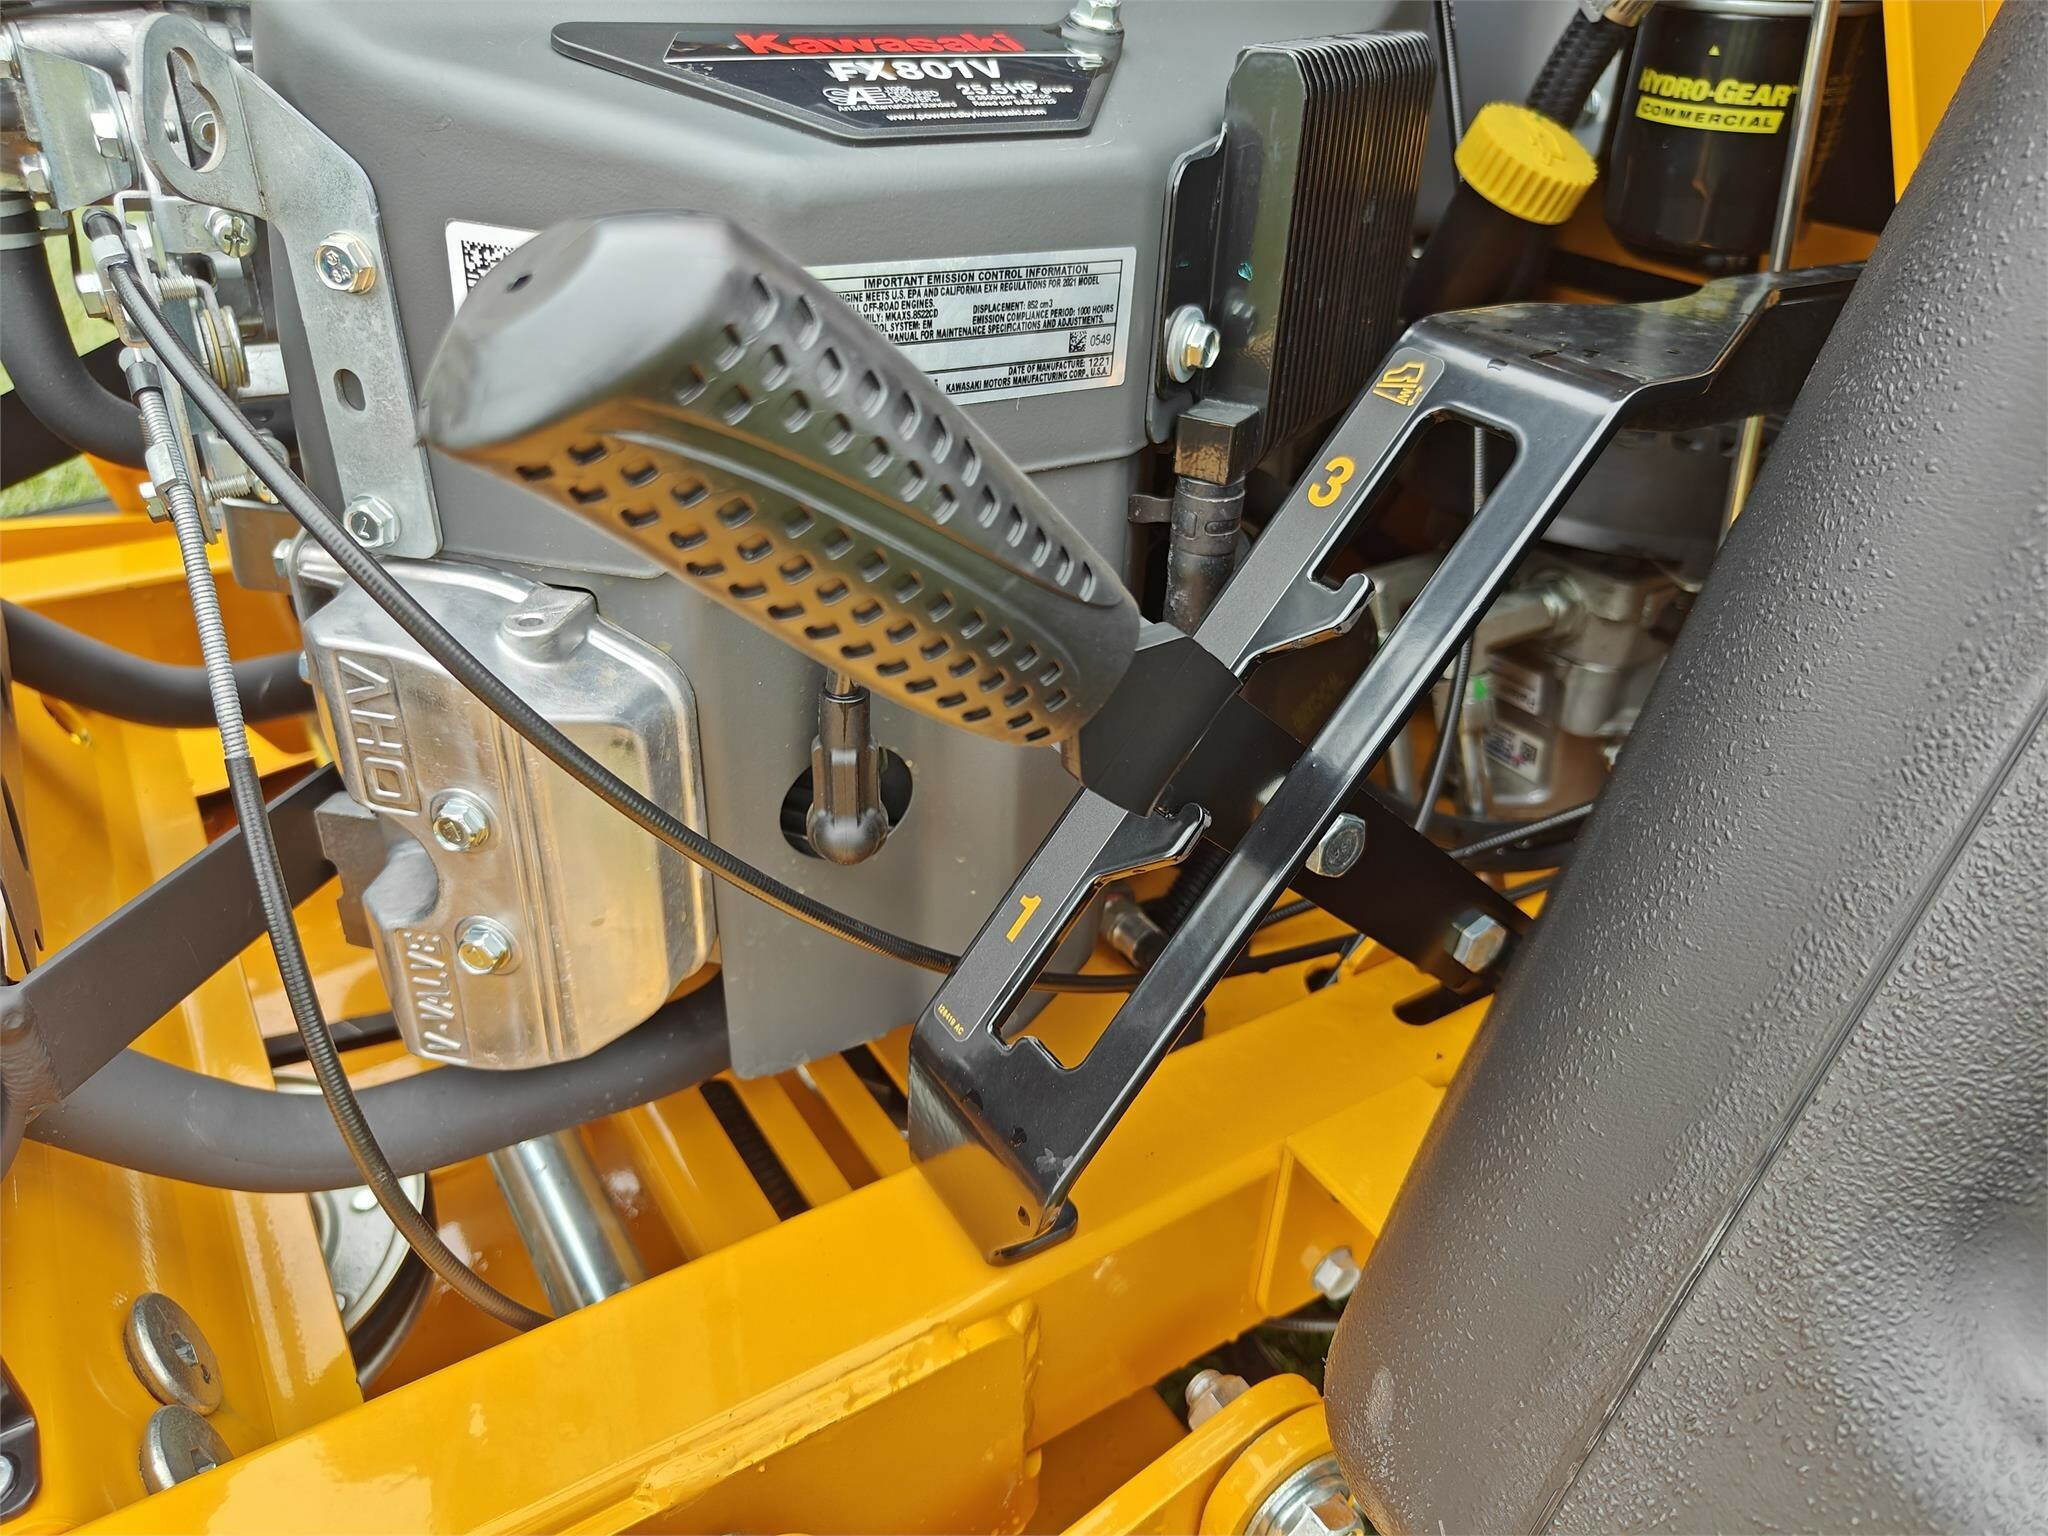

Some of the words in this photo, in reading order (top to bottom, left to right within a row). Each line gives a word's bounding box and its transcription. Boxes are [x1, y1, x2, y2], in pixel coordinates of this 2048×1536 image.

[736, 32, 1025, 54] Kawasaki
[829, 59, 1001, 82] FX801V
[1641, 102, 1773, 128] COMMERCIAL
[864, 275, 925, 289] IMPORTANT
[927, 272, 975, 285] EMISSION
[978, 269, 1023, 281] CONTROL
[1025, 265, 1089, 278] INFORMATION
[865, 291, 890, 302] MEETS
[891, 290, 906, 300] U.S.
[907, 288, 922, 299] EPA
[923, 287, 939, 298] AND
[940, 283, 982, 297] CALIFORNIA
[983, 283, 998, 294] EXH
[1000, 280, 1047, 292] REGULATIONS
[1048, 279, 1061, 289] FOR
[1062, 277, 1077, 287] 2021
[1078, 276, 1100, 286] MODEL
[863, 300, 900, 312] OFF-ROAD
[901, 299, 935, 310] ENGINES.
[890, 321, 921, 332] SYSTEM:
[922, 320, 933, 330] EM
[972, 313, 1005, 326] EMISSION
[1006, 309, 1048, 323] COMPLIANCE
[1050, 307, 1076, 318] PERIOD:
[1077, 305, 1091, 316] 1000
[1092, 303, 1114, 315] HOURS
[973, 301, 1026, 314] DISPLACEMENT:
[921, 329, 934, 340] FOR
[936, 325, 986, 338] MAINTENANCE
[988, 320, 1041, 333] SPECIFICATIONS
[1042, 318, 1057, 329] AND
[1058, 315, 1105, 327] ADJUSTMENTS.
[1090, 333, 1112, 347] 0549
[1008, 364, 1026, 375] DATE
[1026, 363, 1036, 374] OF
[1036, 360, 1086, 373] MANUFACTURE:
[1088, 357, 1110, 367] 1221
[946, 378, 982, 392] KAWASAKI
[983, 376, 1011, 389] MOTORS
[1012, 370, 1068, 385] MANUFACTURING
[1090, 366, 1108, 376] U.S.A.
[1307, 456, 1356, 507] 3
[338, 655, 410, 800] OHV
[1006, 895, 1042, 943] 1
[403, 931, 462, 1053] V-VALVE
